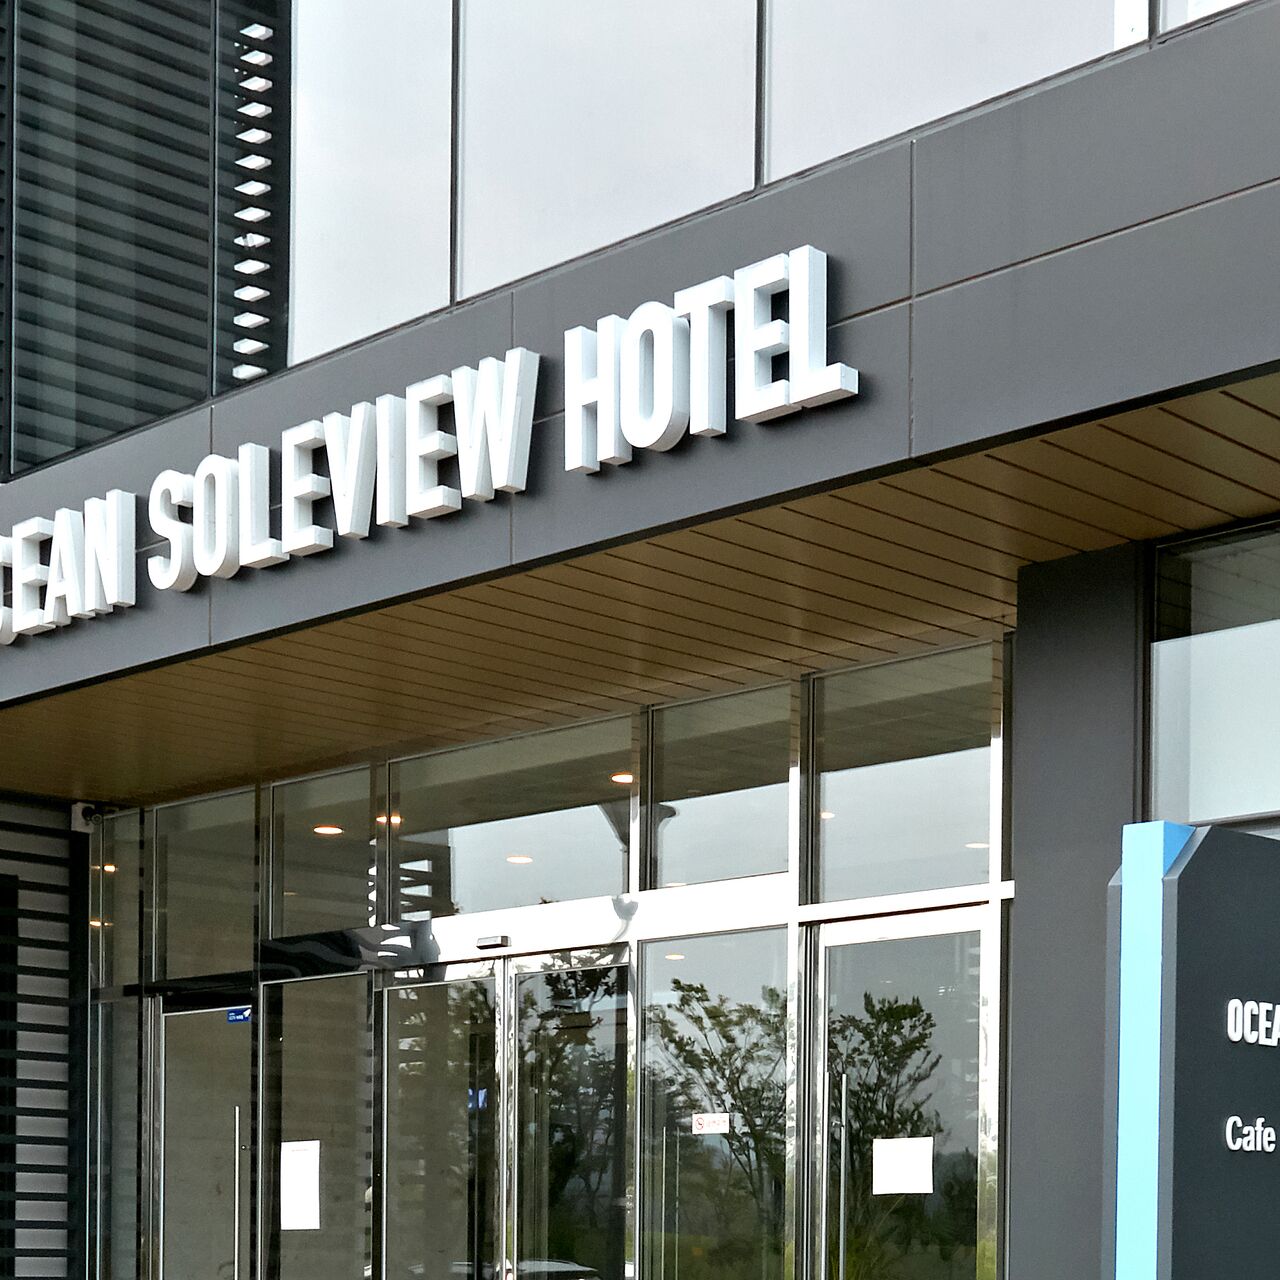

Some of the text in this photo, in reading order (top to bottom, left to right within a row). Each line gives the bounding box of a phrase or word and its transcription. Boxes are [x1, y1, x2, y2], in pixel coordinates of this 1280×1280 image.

[146, 346, 540, 592] SOLEVIEW
[564, 244, 859, 474] HOTEL
[1225, 1114, 1277, 1153] Cafe
